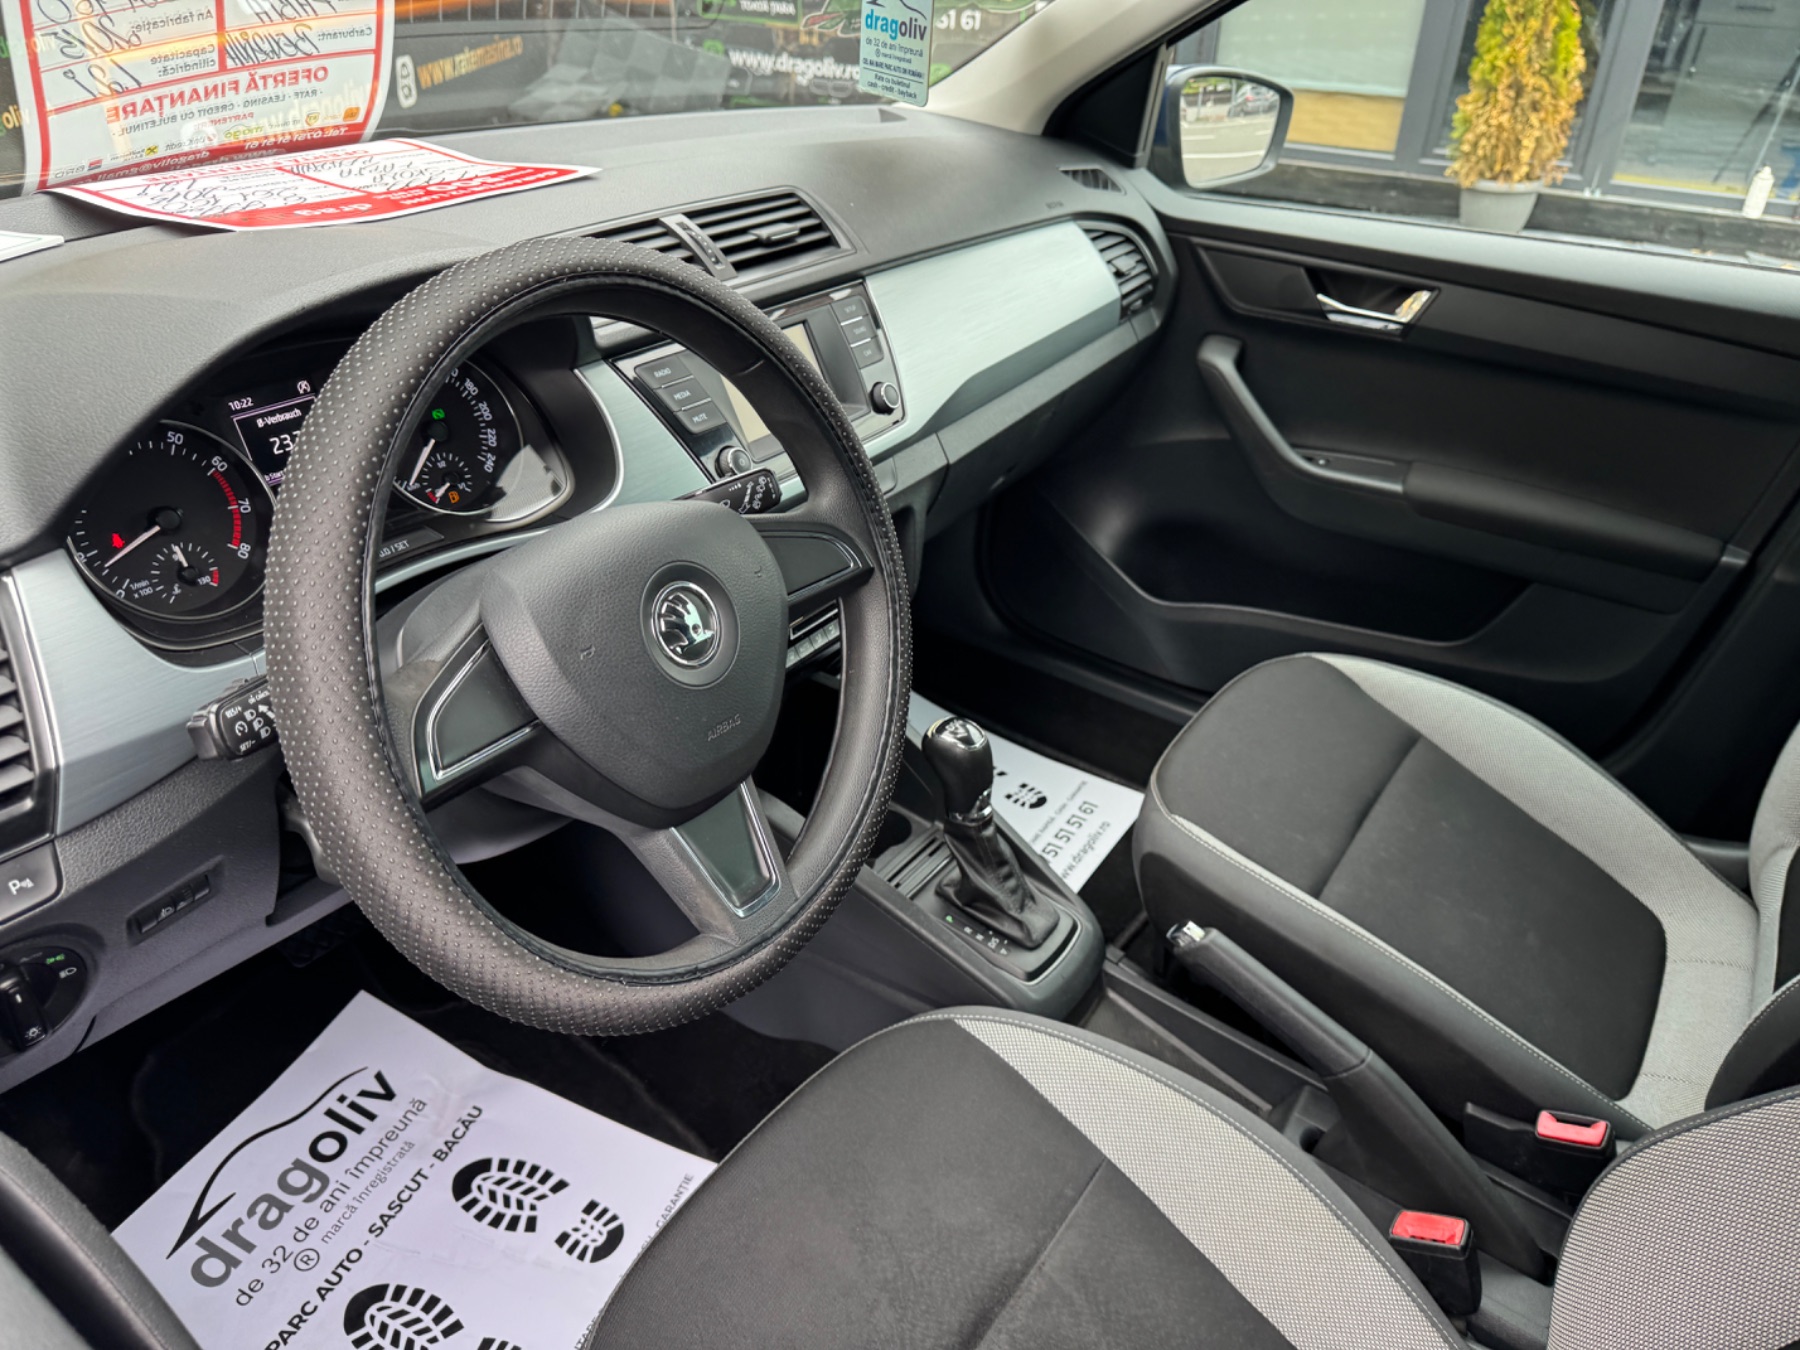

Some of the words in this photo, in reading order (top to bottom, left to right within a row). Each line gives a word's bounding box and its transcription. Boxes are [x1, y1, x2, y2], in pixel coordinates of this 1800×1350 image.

[865, 9, 927, 41] dragoliv
[961, 9, 981, 31] 61
[653, 367, 672, 378] RADIO
[464, 378, 478, 396] 180
[673, 389, 690, 401] MEDIA
[229, 396, 254, 411] 10:22
[478, 400, 493, 421] 200
[692, 413, 708, 424] MUTE
[167, 431, 184, 445] 50
[487, 428, 497, 447] 220
[211, 455, 228, 473] 60
[484, 452, 496, 473] 240
[238, 497, 252, 514] 70
[238, 543, 251, 560] 80
[395, 539, 409, 551] SET
[130, 579, 150, 591] 1/min
[198, 575, 211, 585] 130
[140, 586, 154, 597] 100
[707, 714, 741, 741] AIRBAG
[1054, 828, 1076, 843] 51
[1066, 814, 1087, 829] 51
[1078, 801, 1099, 814] 61
[190, 1070, 397, 1288] dragoliv
[321, 1204, 358, 1244] marcă
[356, 1139, 415, 1206] înregistrată
[235, 1278, 264, 1307] de
[261, 1244, 294, 1275] 32
[293, 1215, 320, 1243] de
[320, 1179, 350, 1214] ani
[345, 1097, 427, 1179] împreună
[265, 1300, 319, 1350] PARC
[316, 1247, 363, 1302] AUTO
[368, 1168, 429, 1238] SASCUT
[433, 1104, 483, 1162] BACĂU
